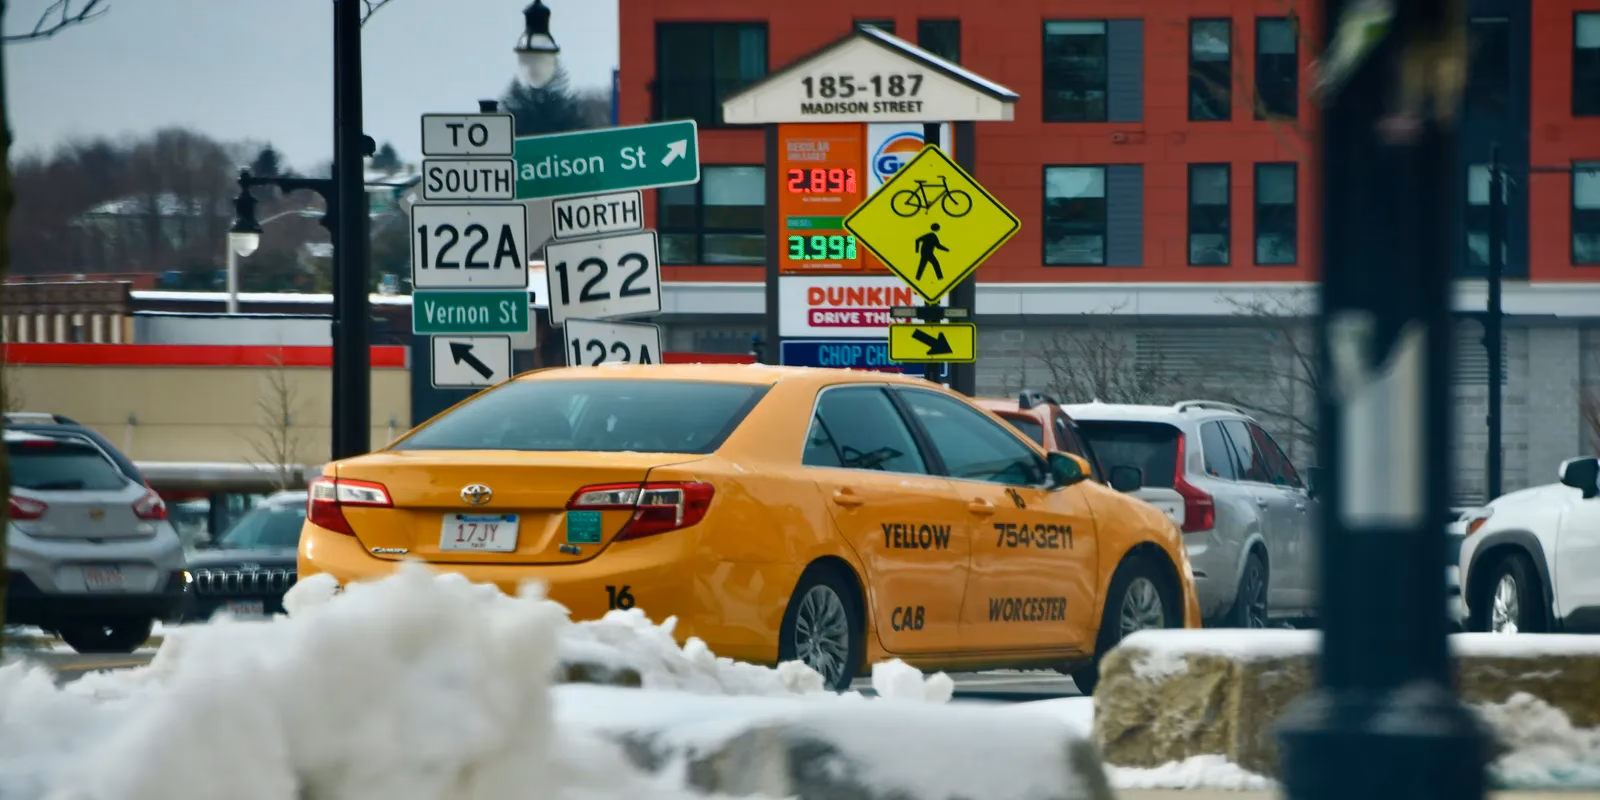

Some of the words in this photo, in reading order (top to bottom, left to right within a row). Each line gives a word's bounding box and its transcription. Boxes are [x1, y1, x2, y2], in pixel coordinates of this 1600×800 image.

[801, 74, 924, 98] 185-187
[801, 102, 868, 115] MADISON
[873, 101, 923, 113] STREET
[446, 123, 489, 147] TO
[620, 146, 647, 170] St
[428, 166, 510, 193] SOUTH
[557, 200, 637, 231] NORTH
[417, 223, 522, 270] 122A
[555, 252, 652, 306] 122
[424, 301, 490, 325] Vernon
[499, 300, 518, 324] St
[813, 312, 860, 324] DRIVE
[819, 345, 862, 366] CHOP
[1005, 488, 1026, 509] 16
[456, 524, 499, 542] 17JY
[881, 523, 951, 549] YELLOW
[604, 585, 635, 611] 16
[988, 597, 1067, 623] WORCESTER
[891, 605, 925, 631] CAB
